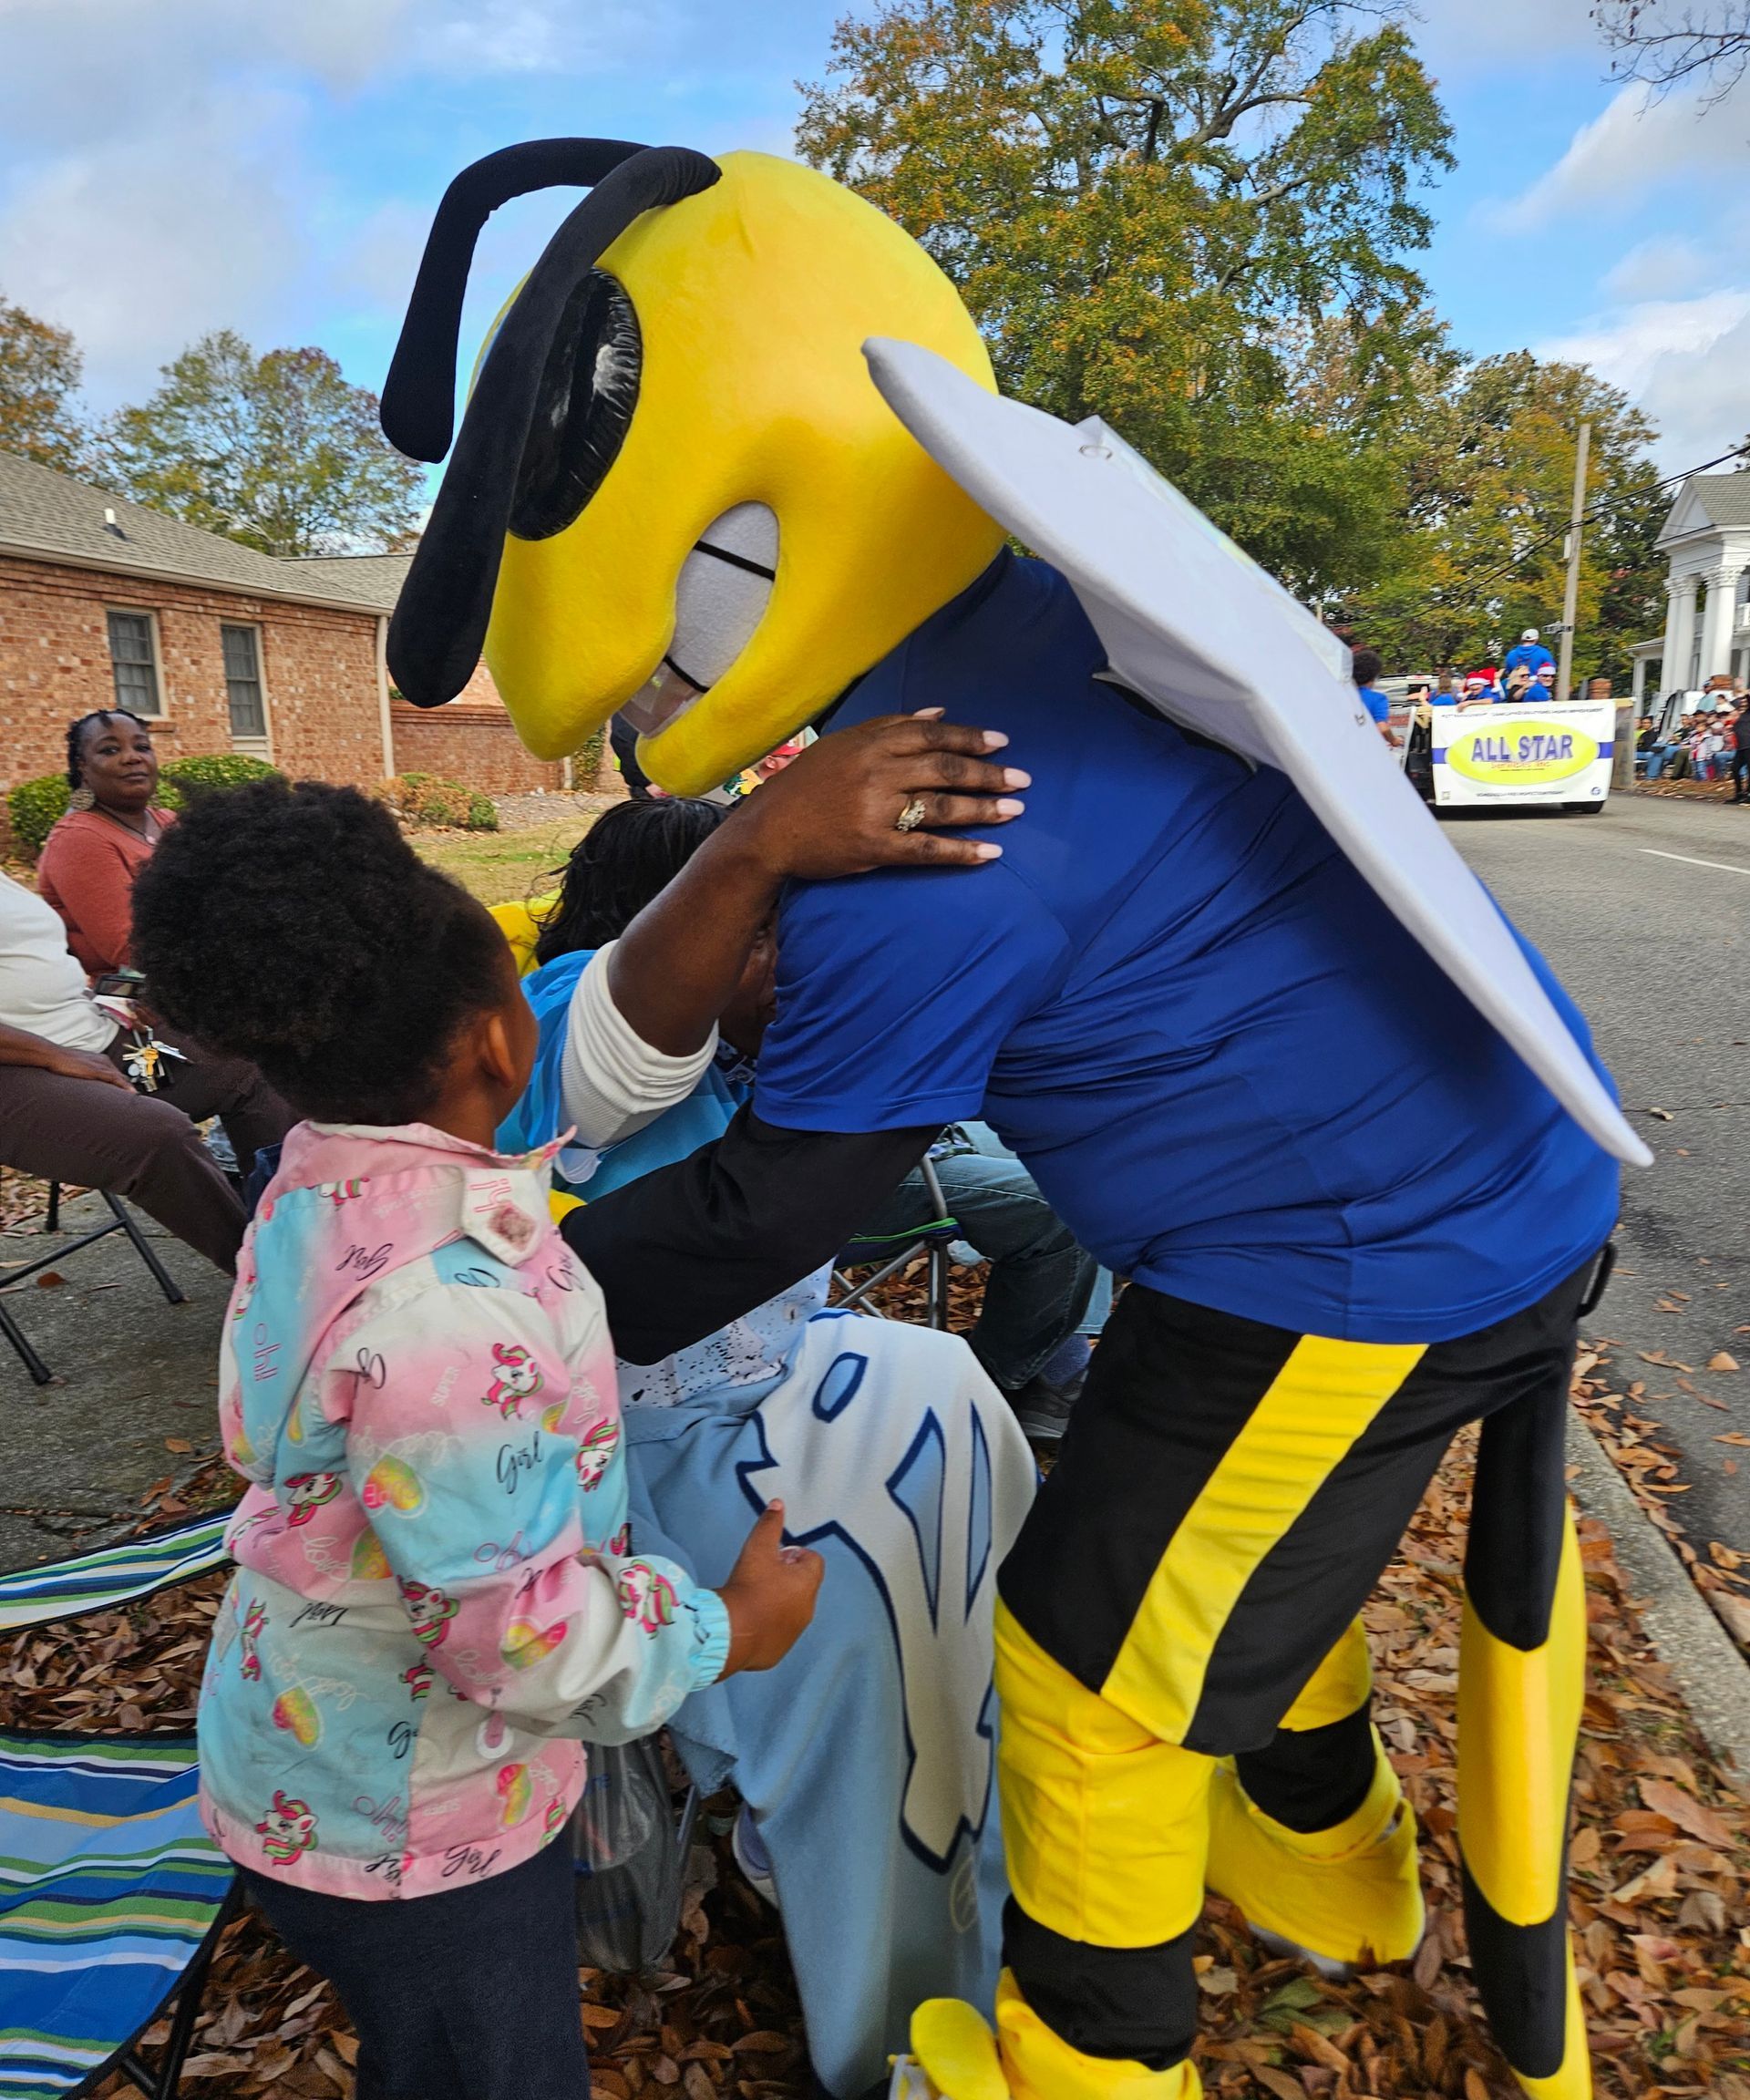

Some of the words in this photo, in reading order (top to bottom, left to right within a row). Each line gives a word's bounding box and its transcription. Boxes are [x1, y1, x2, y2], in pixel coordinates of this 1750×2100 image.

[1471, 736, 1510, 762] ALL
[1518, 734, 1574, 760] STAR
[496, 1430, 543, 1495] Girl
[440, 1844, 503, 1879] Girl
